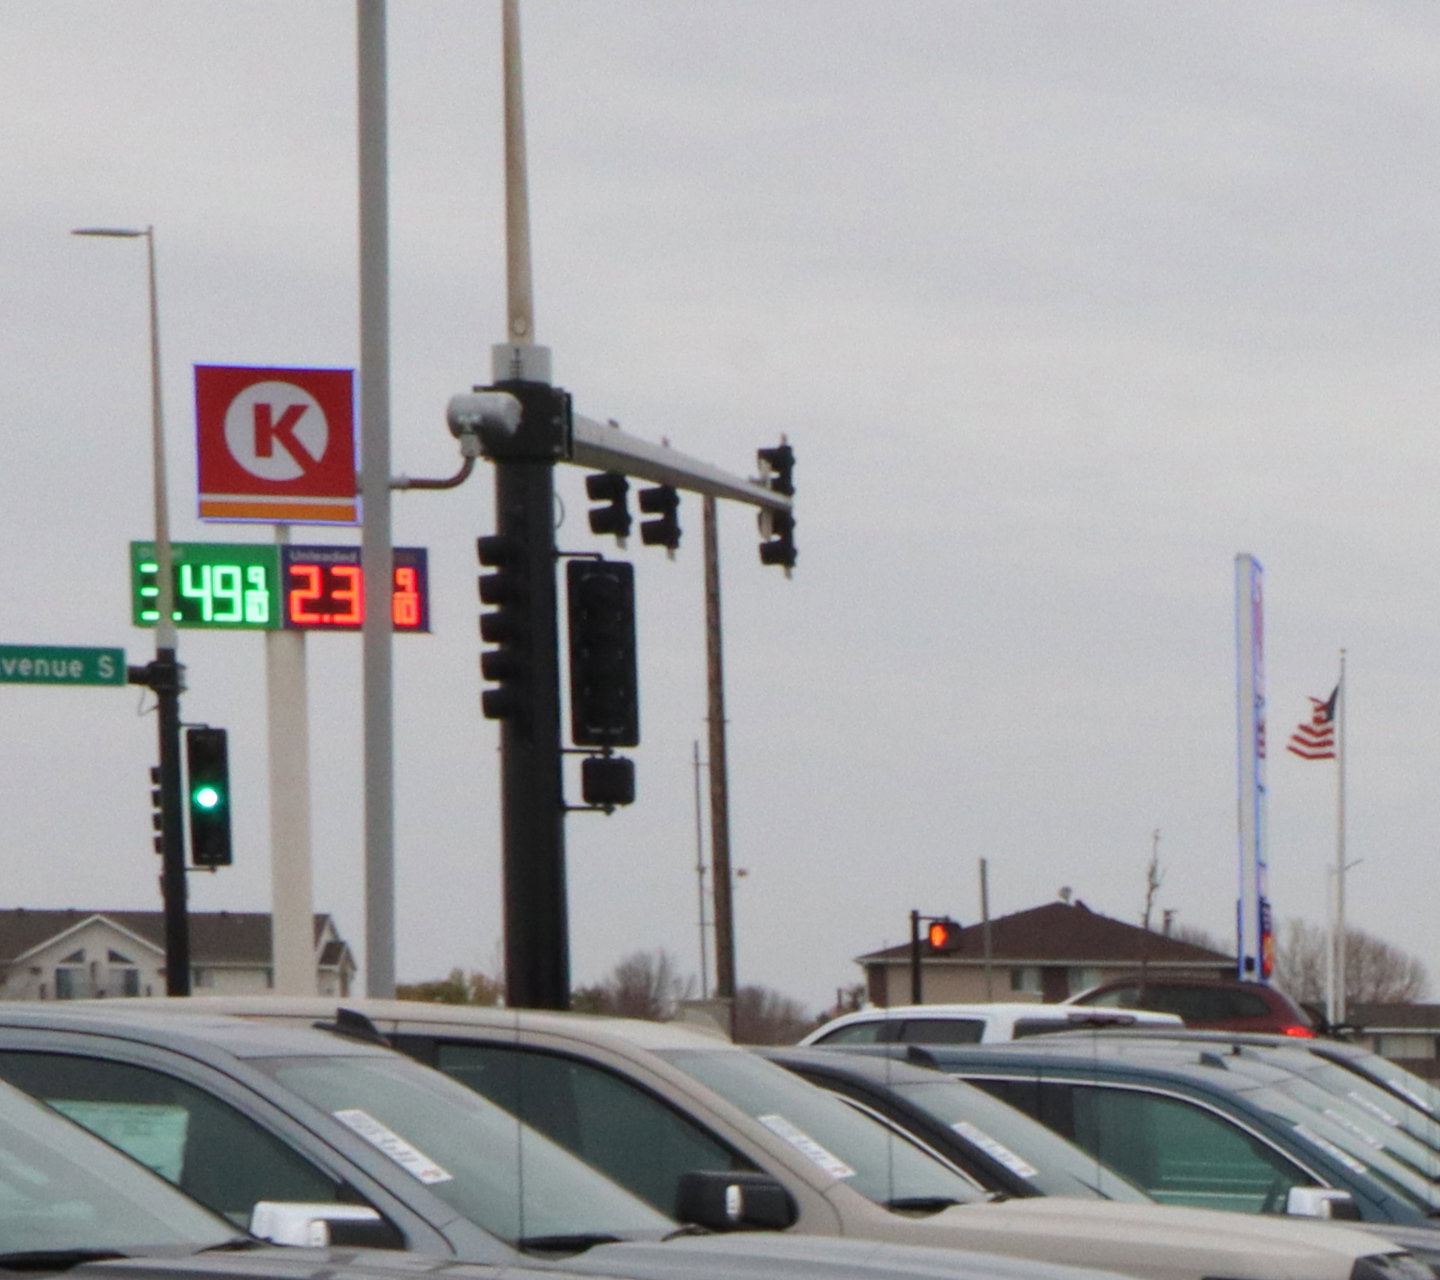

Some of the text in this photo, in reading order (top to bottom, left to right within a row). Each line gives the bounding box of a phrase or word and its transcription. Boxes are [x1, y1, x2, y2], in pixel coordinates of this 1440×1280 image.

[288, 565, 364, 624] 2.3
[1, 655, 114, 678] venue S
